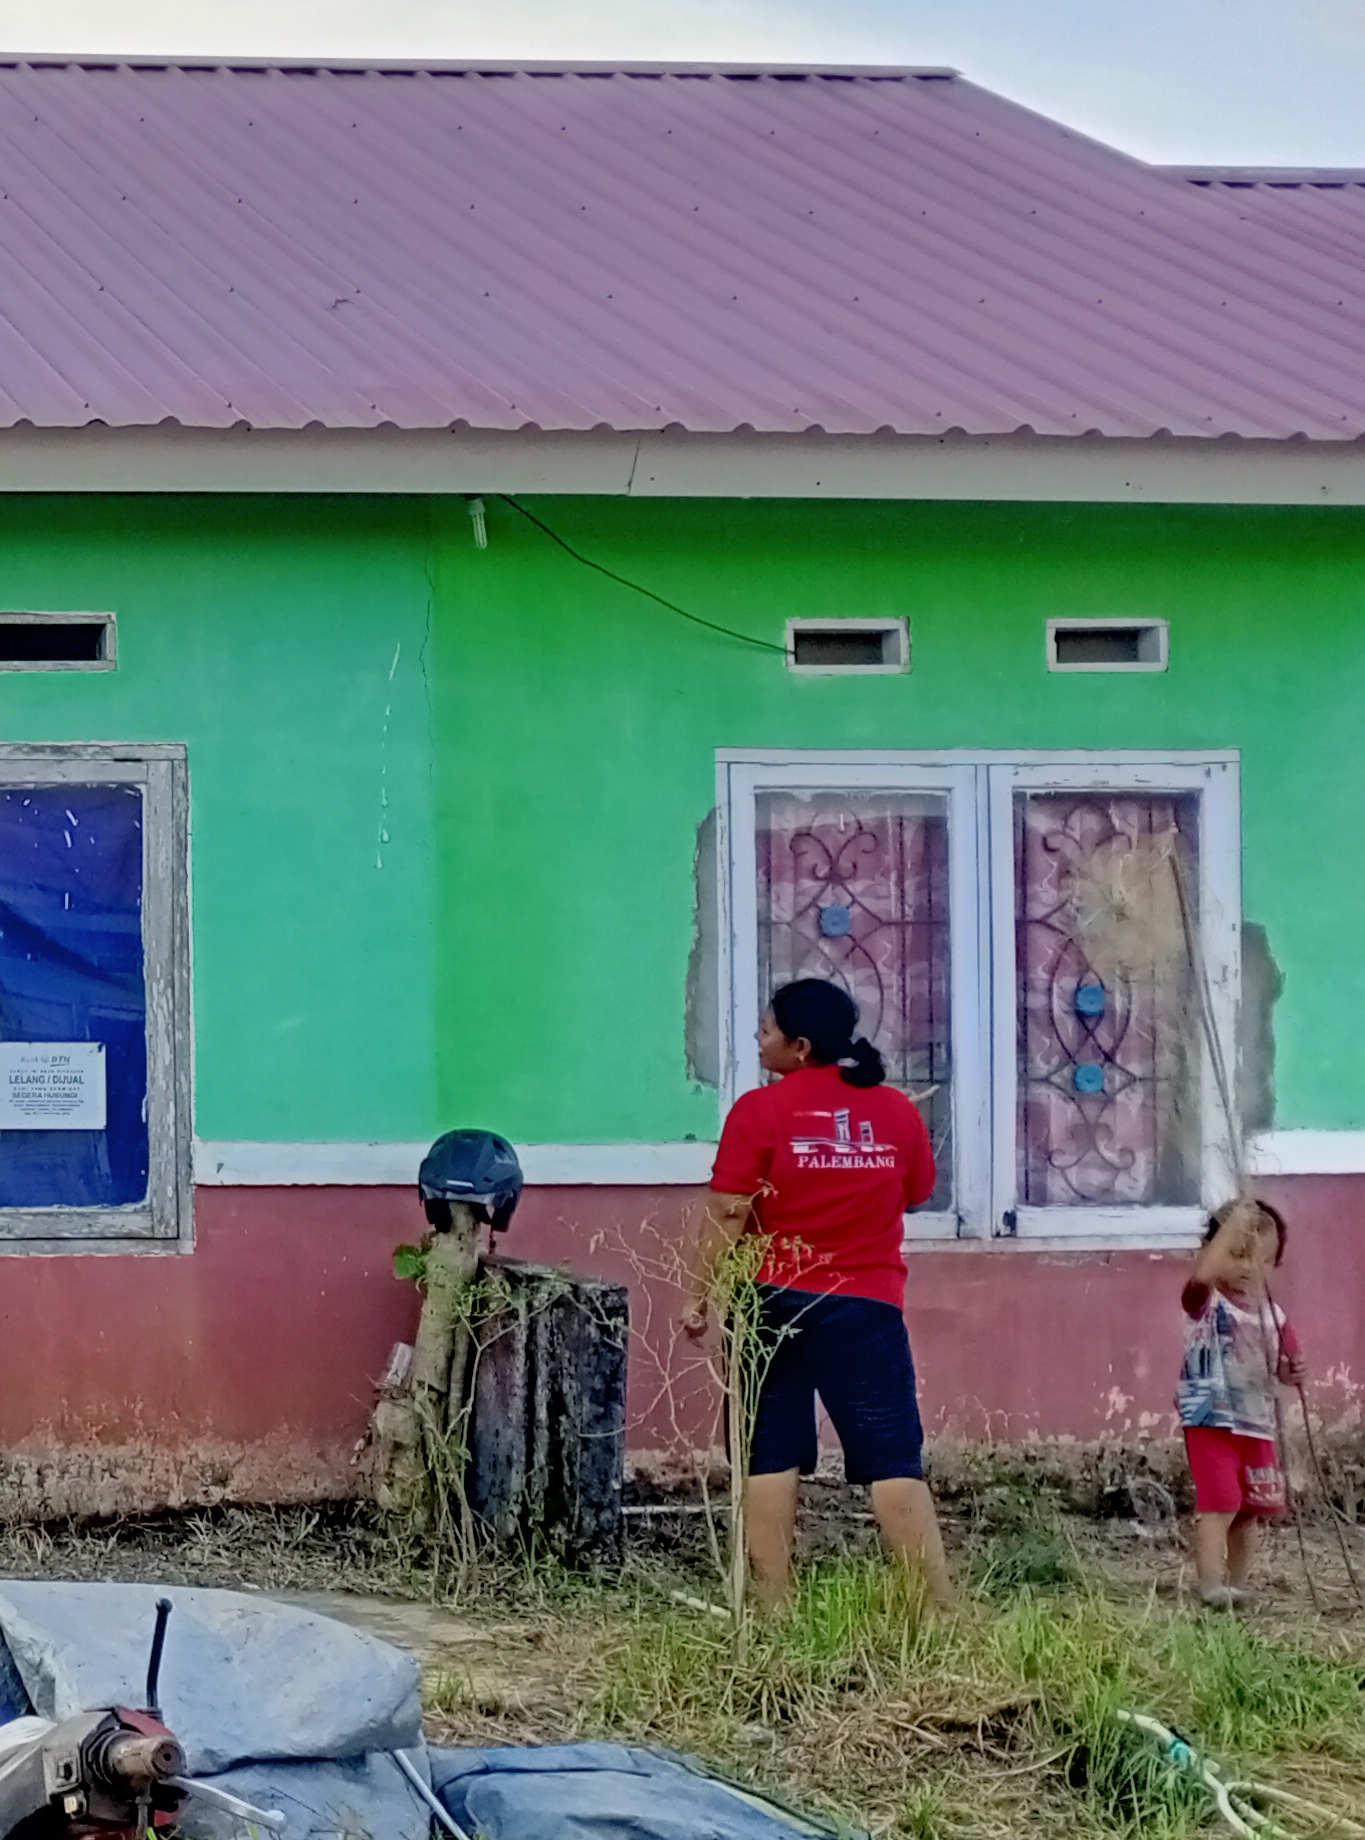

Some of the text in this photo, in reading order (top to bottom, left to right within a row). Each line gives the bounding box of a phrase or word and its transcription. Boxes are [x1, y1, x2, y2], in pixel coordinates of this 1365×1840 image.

[51, 1055, 71, 1064] BTN
[9, 1075, 45, 1084] LELANG
[52, 1075, 85, 1084] DIJUAL
[797, 1155, 895, 1169] PALEMBANG
